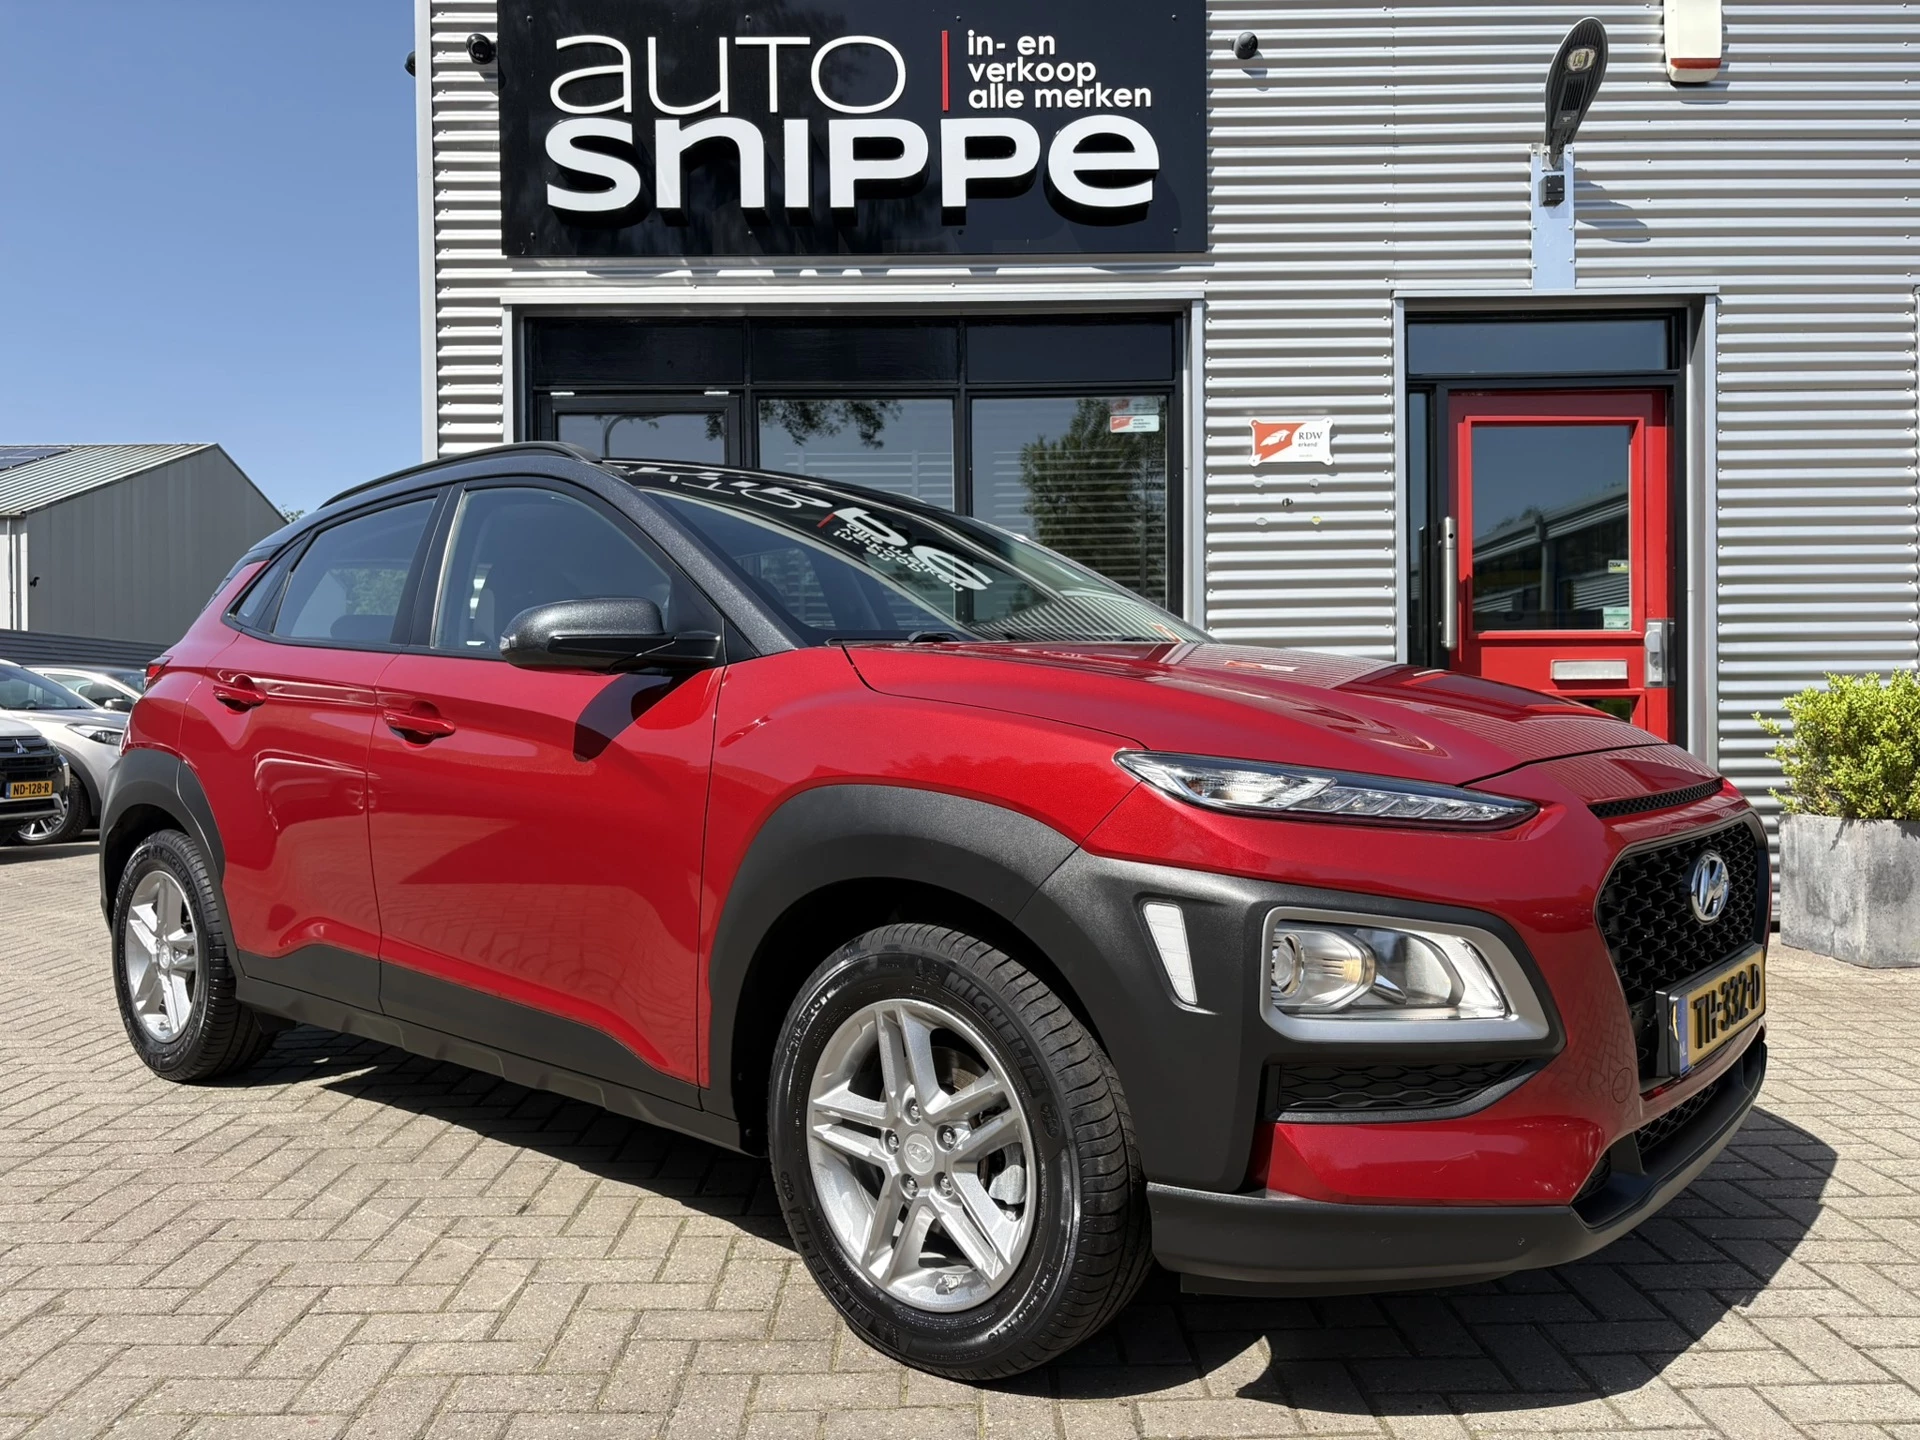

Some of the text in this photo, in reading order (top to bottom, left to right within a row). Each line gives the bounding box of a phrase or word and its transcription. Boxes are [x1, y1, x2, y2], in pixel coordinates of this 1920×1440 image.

[968, 29, 1056, 56] in- en
[968, 56, 1097, 88] verkoop
[968, 82, 1152, 109] alle merken
[1298, 431, 1323, 441] RDW
[13, 783, 50, 796] ND-128-R
[1690, 963, 1761, 1050] TH-332-D
[943, 970, 1049, 1098] MICHELIN
